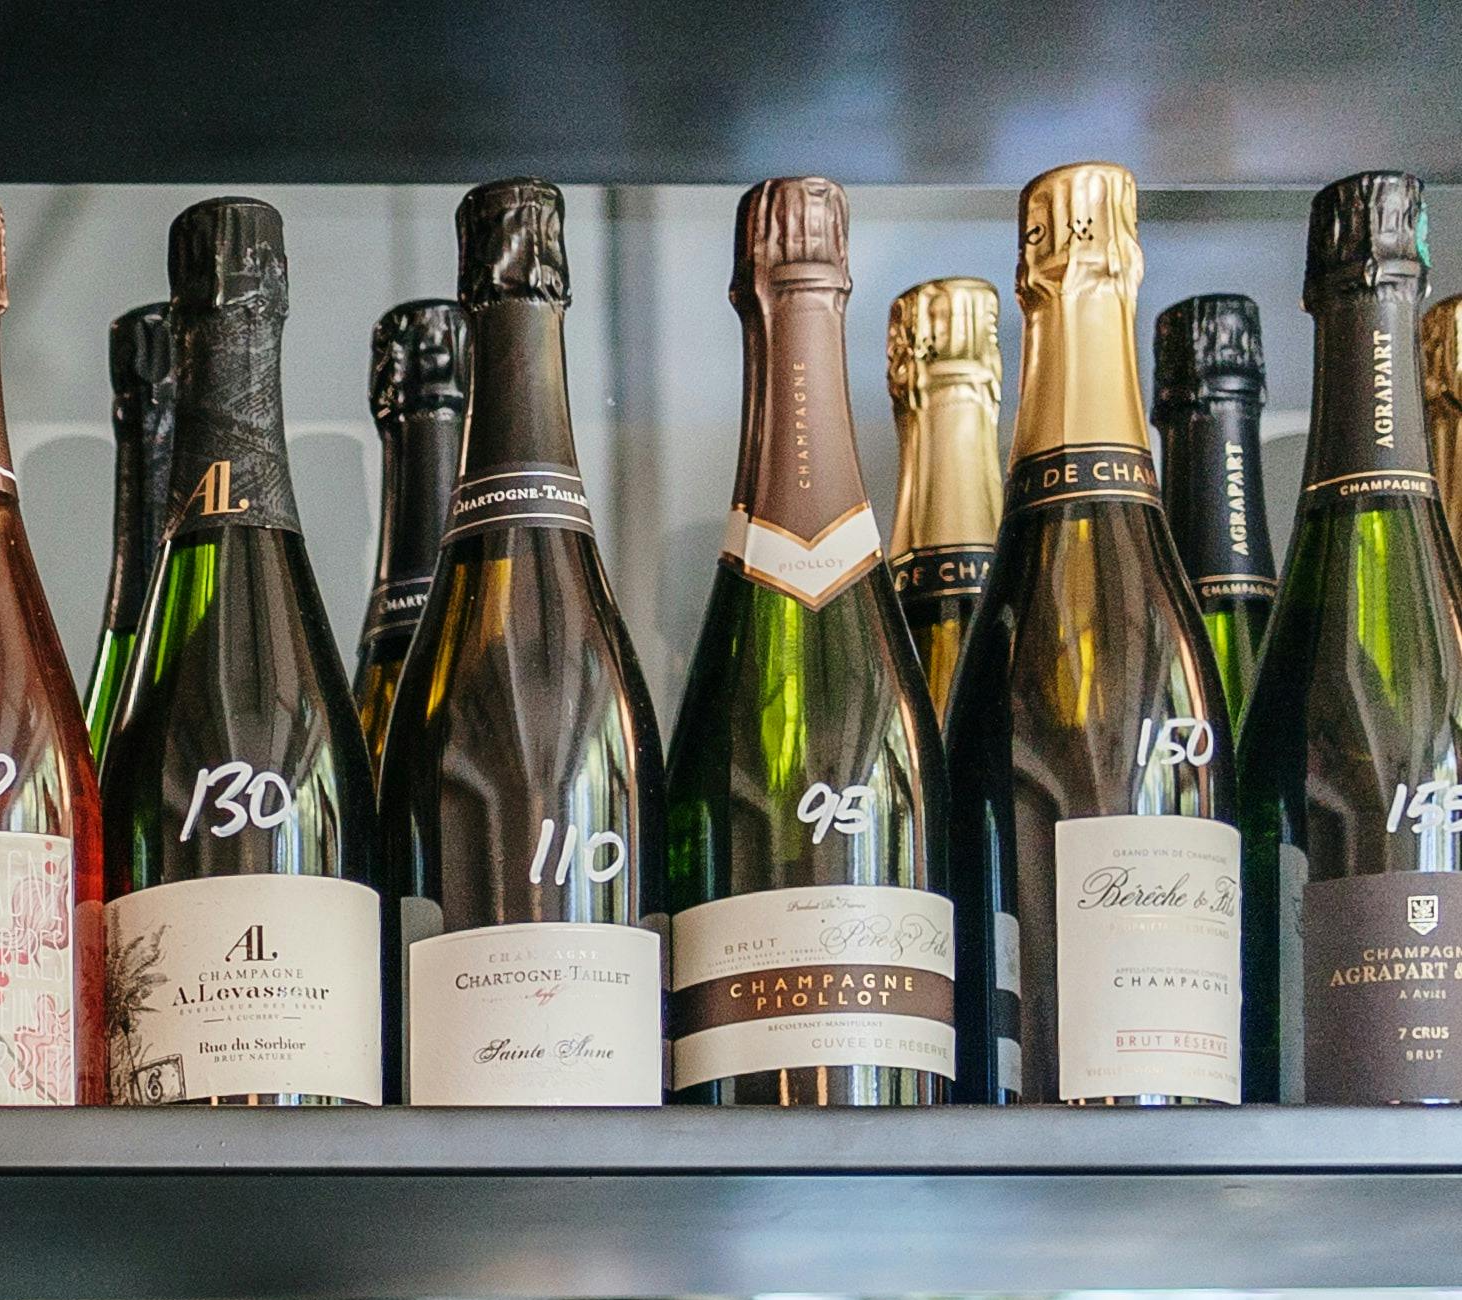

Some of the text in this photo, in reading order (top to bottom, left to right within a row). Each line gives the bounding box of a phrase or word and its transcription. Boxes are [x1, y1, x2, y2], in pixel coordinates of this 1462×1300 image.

[1374, 330, 1394, 450] AGRAPART
[1341, 480, 1428, 498] CHAMPAGNE
[1137, 717, 1214, 767] 150
[180, 762, 292, 842] 130
[797, 782, 876, 845] 95
[528, 819, 625, 885] 110
[723, 937, 778, 956] BRUT
[198, 969, 304, 982] CHAMPAGNE
[454, 965, 631, 992] CHARTOGNE-TAILLET
[730, 973, 915, 999] CHAMPAGNE
[1113, 975, 1229, 996] CHAMPAGNE
[1330, 961, 1446, 987] AGRAPART
[756, 991, 890, 1012] PIOLLOT
[198, 1037, 307, 1055] Rue du Sorbier
[473, 1037, 616, 1066] Sainte Anne
[811, 1037, 949, 1061] CUVÉE DE RÉSERVE
[1115, 1035, 1229, 1055] BRUT RÉSERVE
